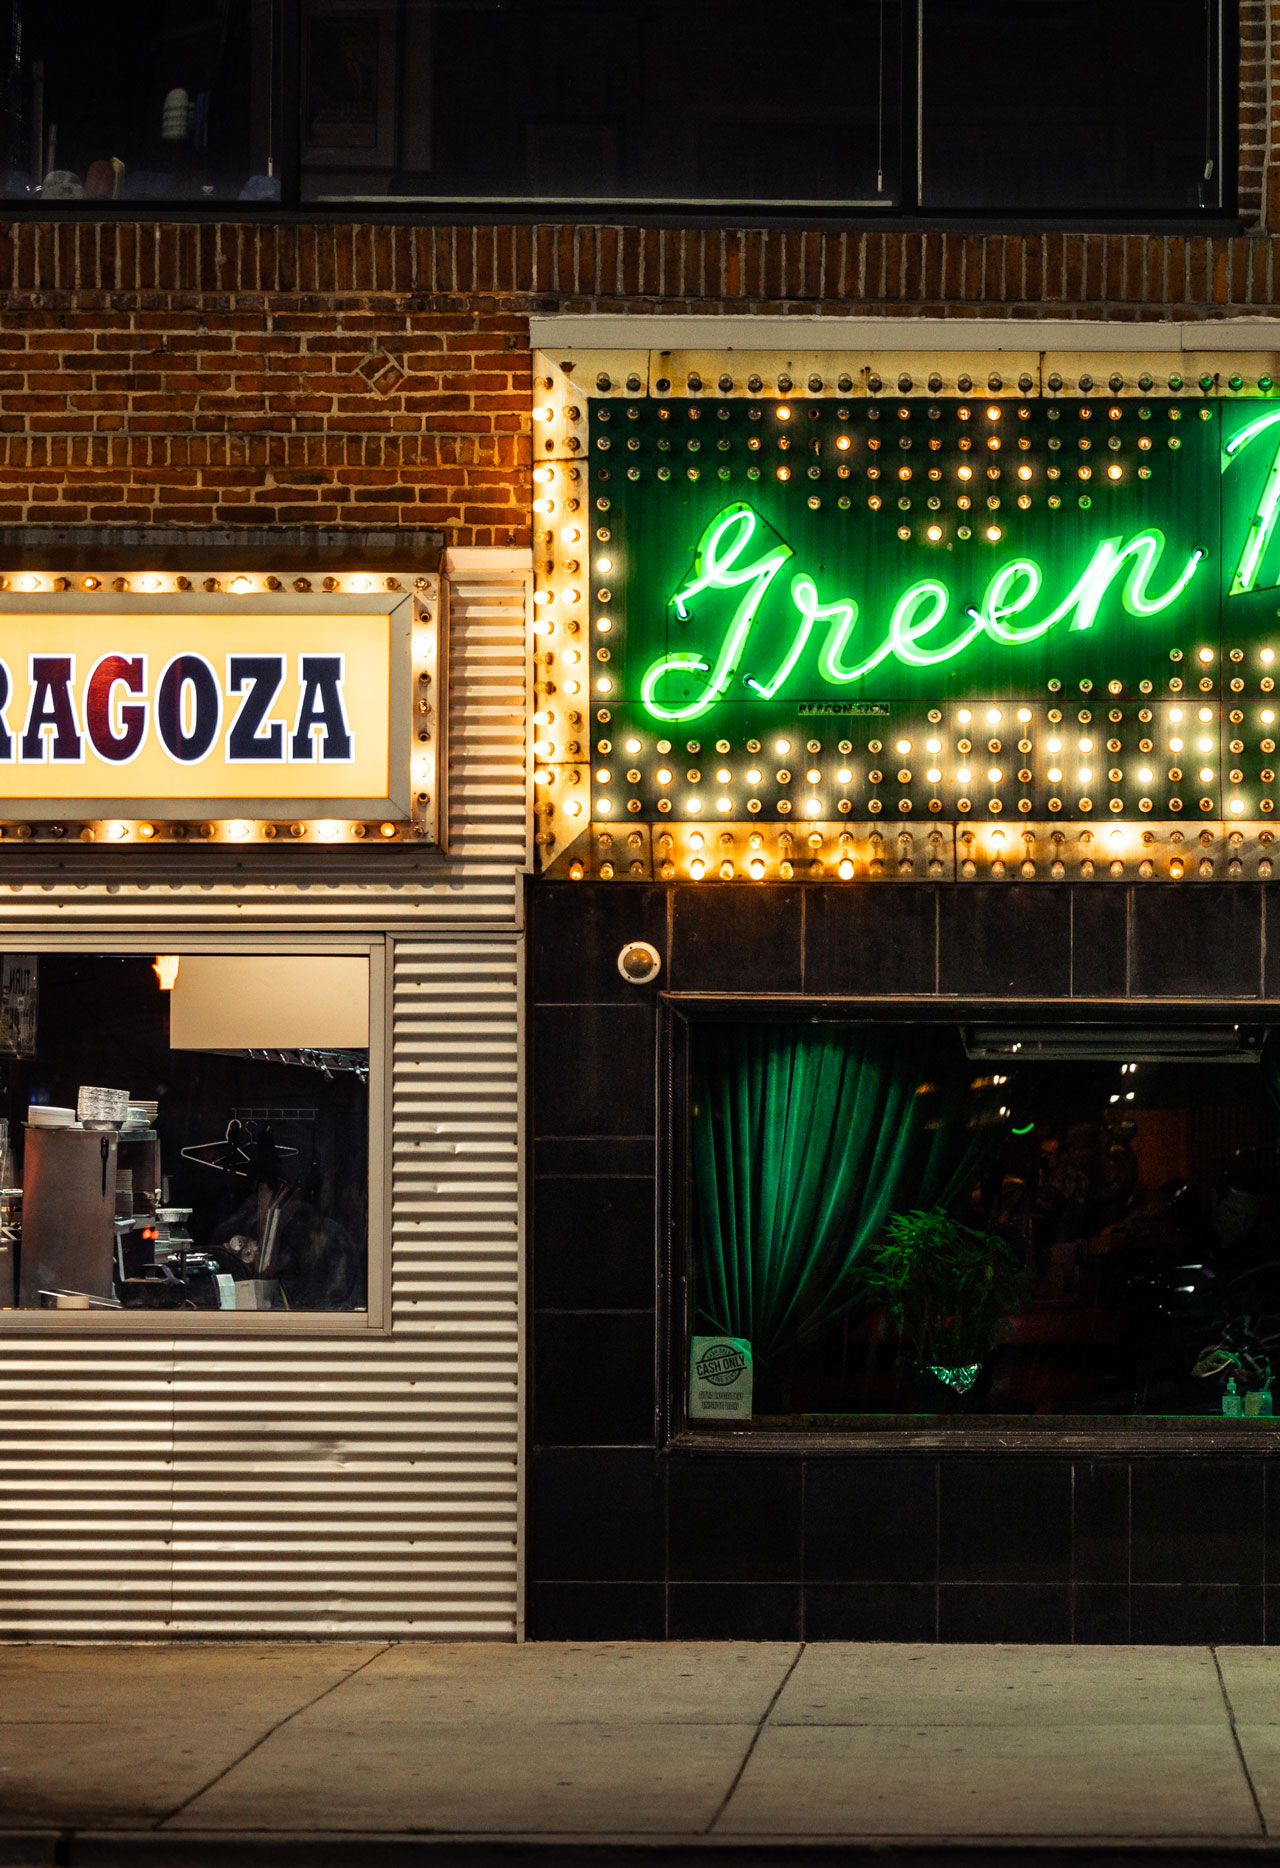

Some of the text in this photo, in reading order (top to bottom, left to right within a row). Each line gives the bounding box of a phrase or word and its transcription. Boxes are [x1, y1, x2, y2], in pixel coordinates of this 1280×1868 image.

[640, 501, 1206, 722] Green
[0, 651, 356, 765] AGOZA
[696, 1355, 745, 1376] CASH ONLY
